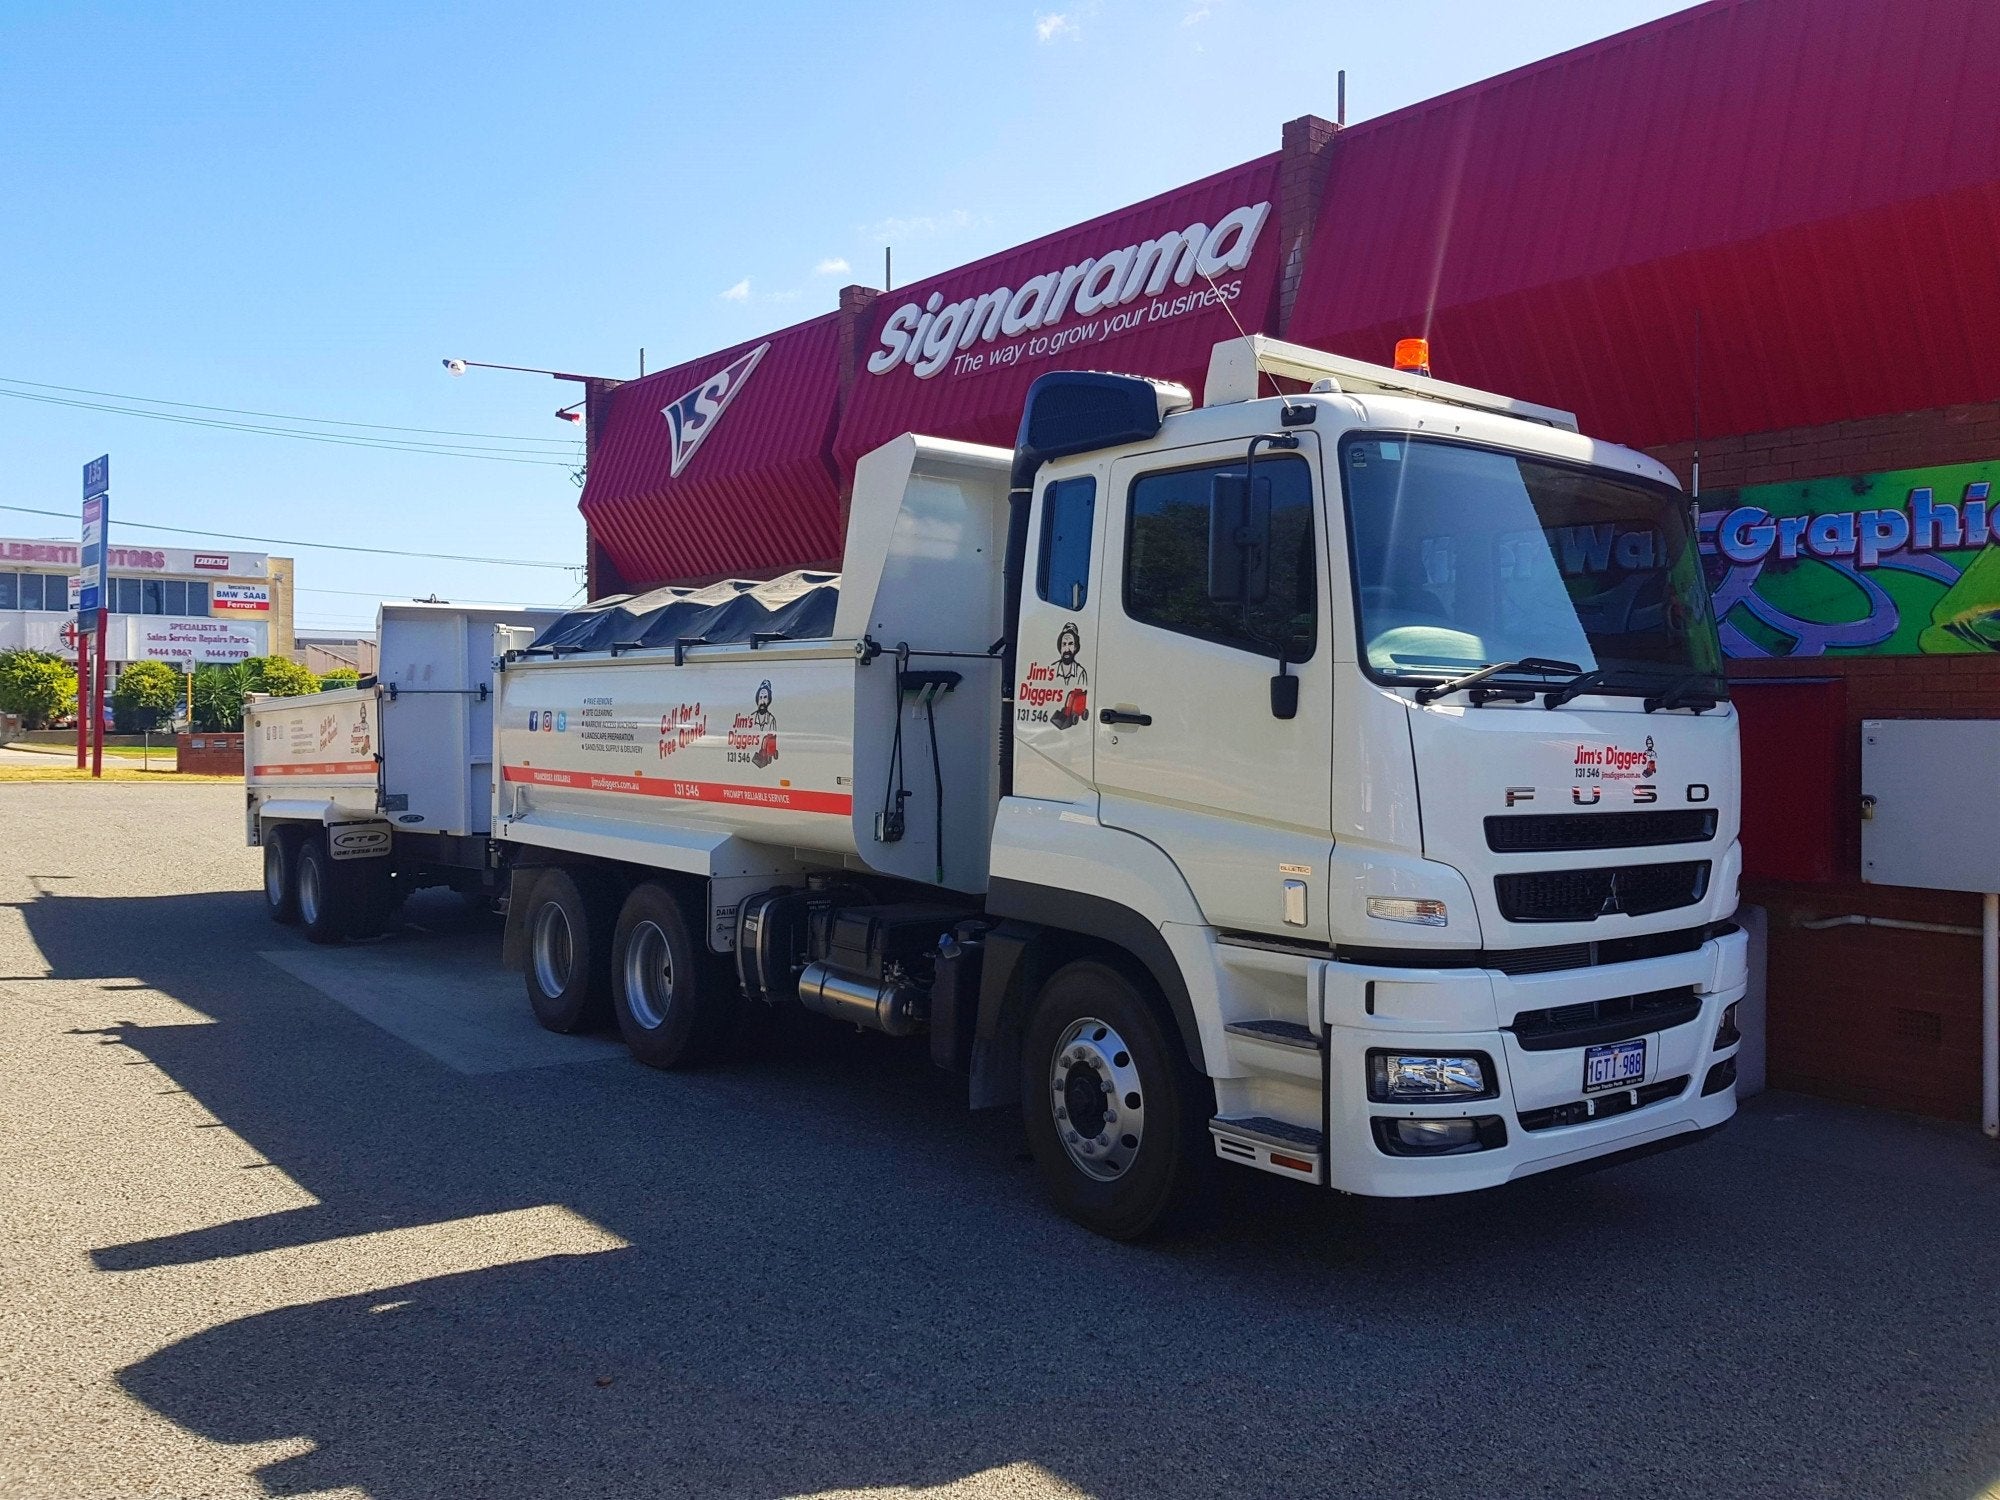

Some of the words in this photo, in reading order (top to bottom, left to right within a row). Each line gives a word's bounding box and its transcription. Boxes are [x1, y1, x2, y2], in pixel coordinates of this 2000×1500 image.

[867, 201, 1271, 380] Signarama
[954, 351, 984, 377] The
[989, 343, 1026, 371] way
[1028, 336, 1048, 356] to
[1049, 320, 1099, 355] grow
[1100, 308, 1147, 344] your
[1148, 279, 1242, 323] business
[107, 549, 165, 568] OTORS
[227, 601, 256, 609] Ferrari
[170, 623, 217, 631] SPECIALISTS
[147, 633, 167, 641] Sales
[169, 634, 197, 642] Service
[199, 634, 227, 645] Repairs
[229, 636, 249, 644] Parts
[148, 648, 168, 656] 9444
[1027, 662, 1055, 681] Jim's
[1019, 682, 1063, 707] Diggers
[661, 708, 678, 735] Call
[680, 703, 692, 724] for
[695, 702, 700, 716] a
[733, 713, 753, 728] Jim's
[1017, 708, 1030, 721] 131
[1031, 709, 1048, 723] 546
[585, 732, 607, 740] LANDSCAPE
[607, 733, 634, 741] PREPARATION
[659, 739, 676, 759] Free
[679, 714, 707, 749] Quote!
[728, 730, 760, 750] Diggers
[727, 752, 736, 762] 131
[738, 752, 751, 763] 546
[1573, 744, 1602, 765] Jim's
[1606, 746, 1648, 770] Diggers
[1575, 768, 1585, 778] 131
[1586, 768, 1600, 778] 546
[591, 776, 640, 791] jimsdiggers.com.au
[673, 783, 684, 795] 131
[686, 784, 699, 797] 546
[723, 789, 744, 799] PROMPT
[744, 791, 767, 801] RELIABLE
[768, 793, 790, 804] SERVICE
[1504, 783, 1710, 808] FUSO
[716, 908, 736, 917] DAIM
